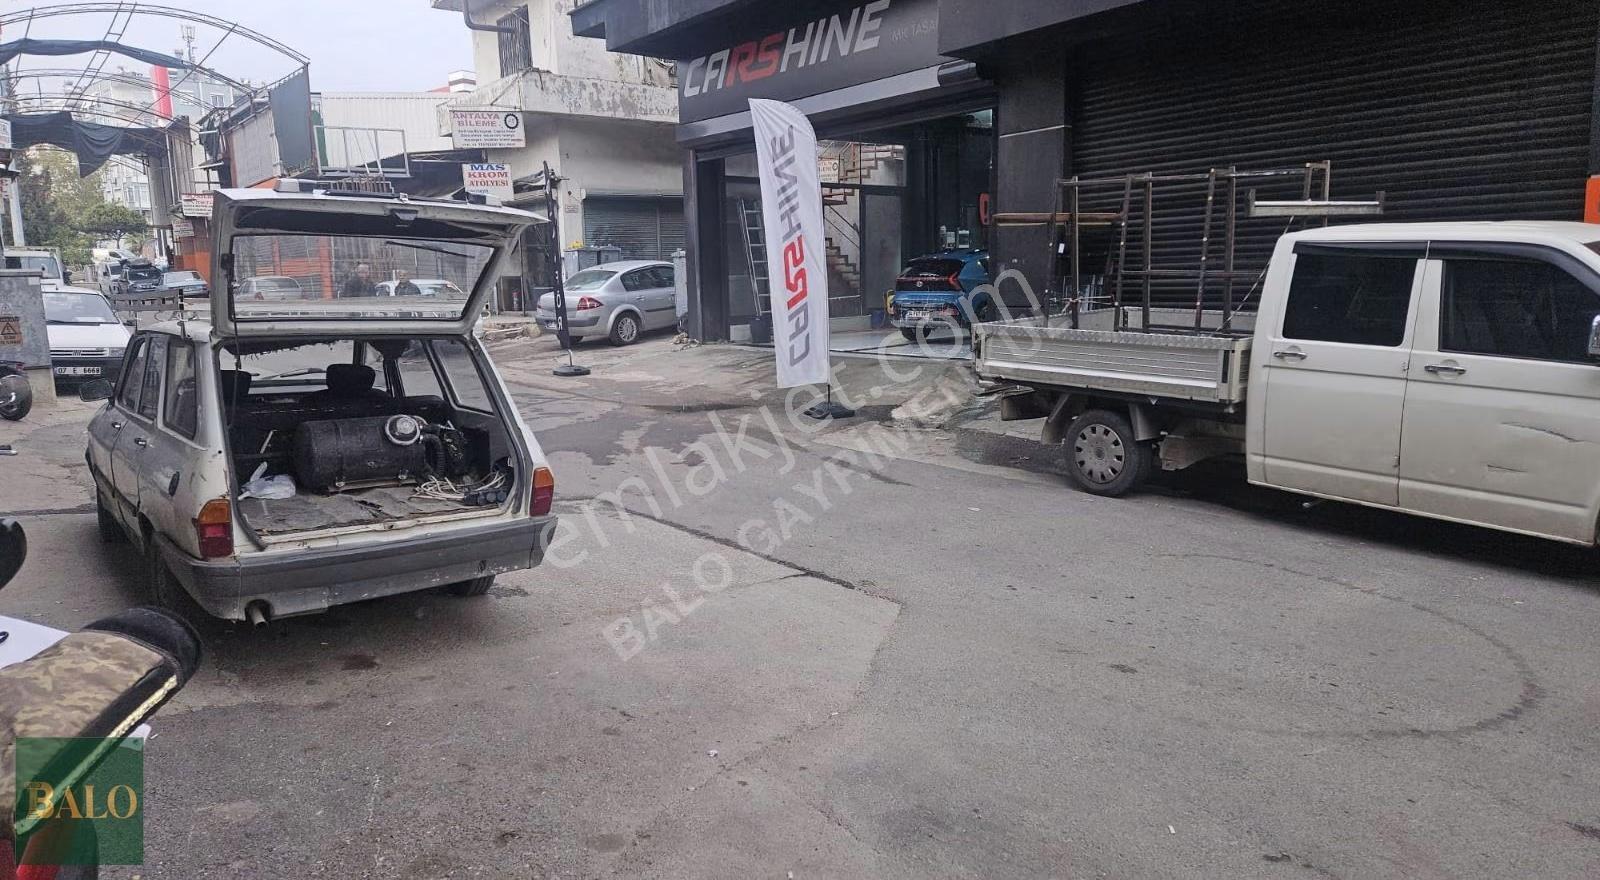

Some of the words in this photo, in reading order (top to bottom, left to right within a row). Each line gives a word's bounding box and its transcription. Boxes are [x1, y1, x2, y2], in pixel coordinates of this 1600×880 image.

[684, 0, 890, 98] CARSHINE
[453, 112, 500, 120] ANTALYA
[468, 171, 508, 179] KROM
